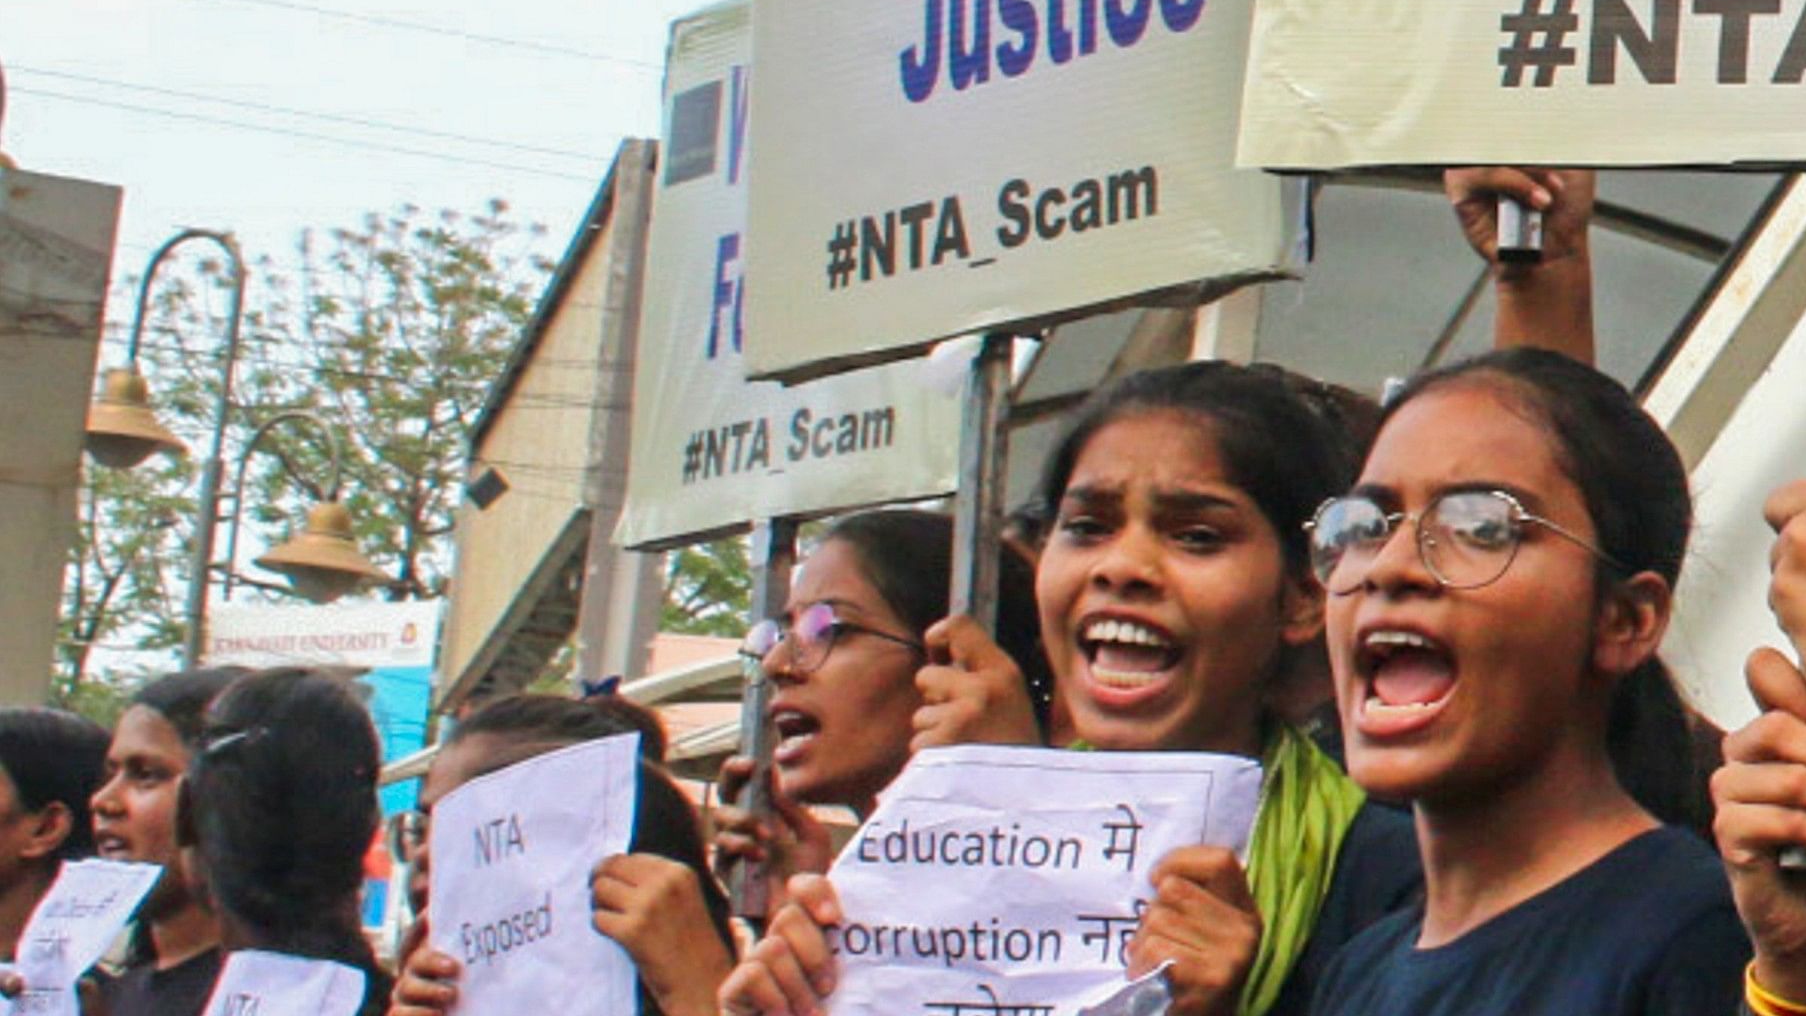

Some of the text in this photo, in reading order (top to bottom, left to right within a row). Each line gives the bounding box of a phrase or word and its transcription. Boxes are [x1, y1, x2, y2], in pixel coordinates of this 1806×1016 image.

[827, 165, 1159, 290] #NTA_Scam
[683, 405, 895, 485] #NTA_Scam
[474, 813, 525, 869] NTA
[858, 818, 1082, 870] Education
[461, 891, 552, 965] Exposed
